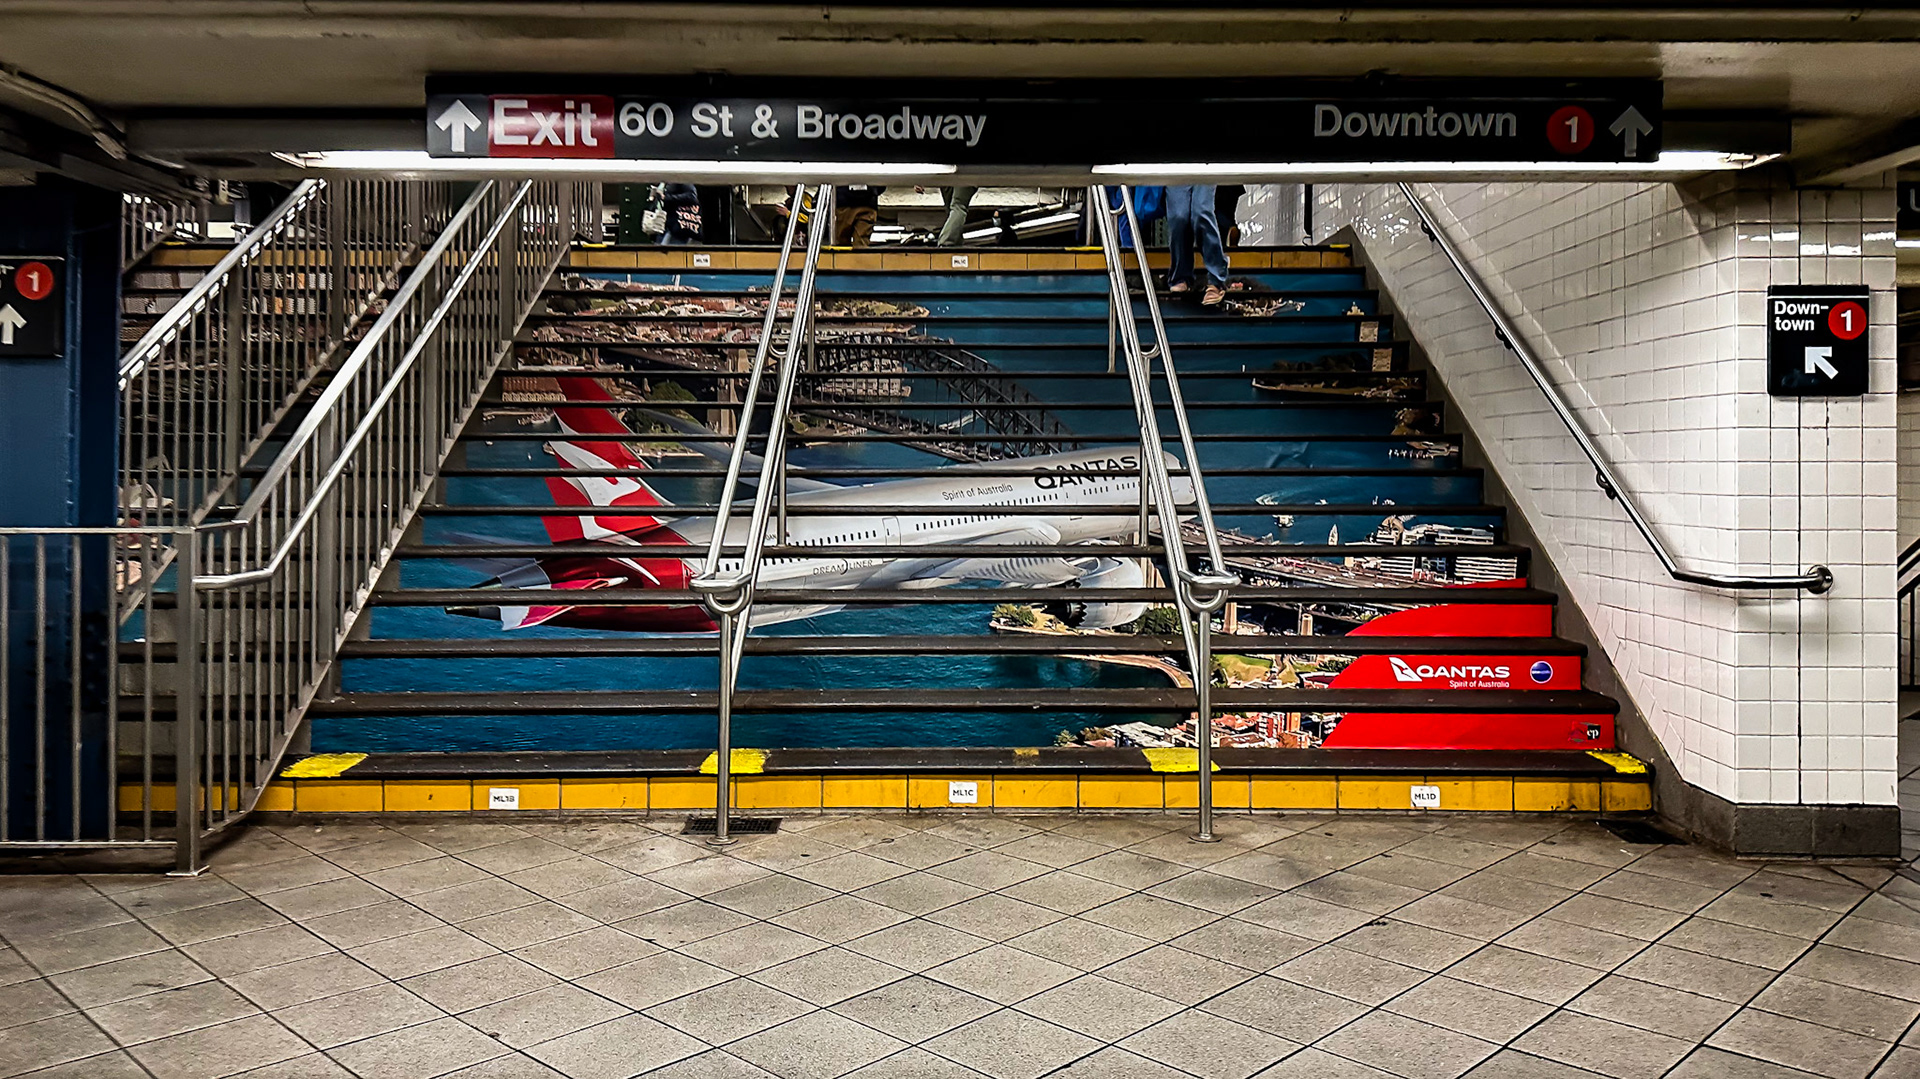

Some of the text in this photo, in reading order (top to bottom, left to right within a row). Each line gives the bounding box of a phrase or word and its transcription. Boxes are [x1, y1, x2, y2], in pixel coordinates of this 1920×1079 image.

[494, 99, 987, 147] Exit 60 St & Broadway
[1314, 104, 1579, 143] Downtown 1
[26, 270, 39, 292] 1
[1774, 300, 1829, 315] Down-
[1775, 316, 1815, 331] town
[1840, 309, 1852, 331] 1
[1033, 456, 1138, 489] QANTAS
[942, 483, 1014, 501] Spirit of Australia
[1416, 665, 1510, 678] QANTAS
[1449, 680, 1510, 689] Spirit of Australia
